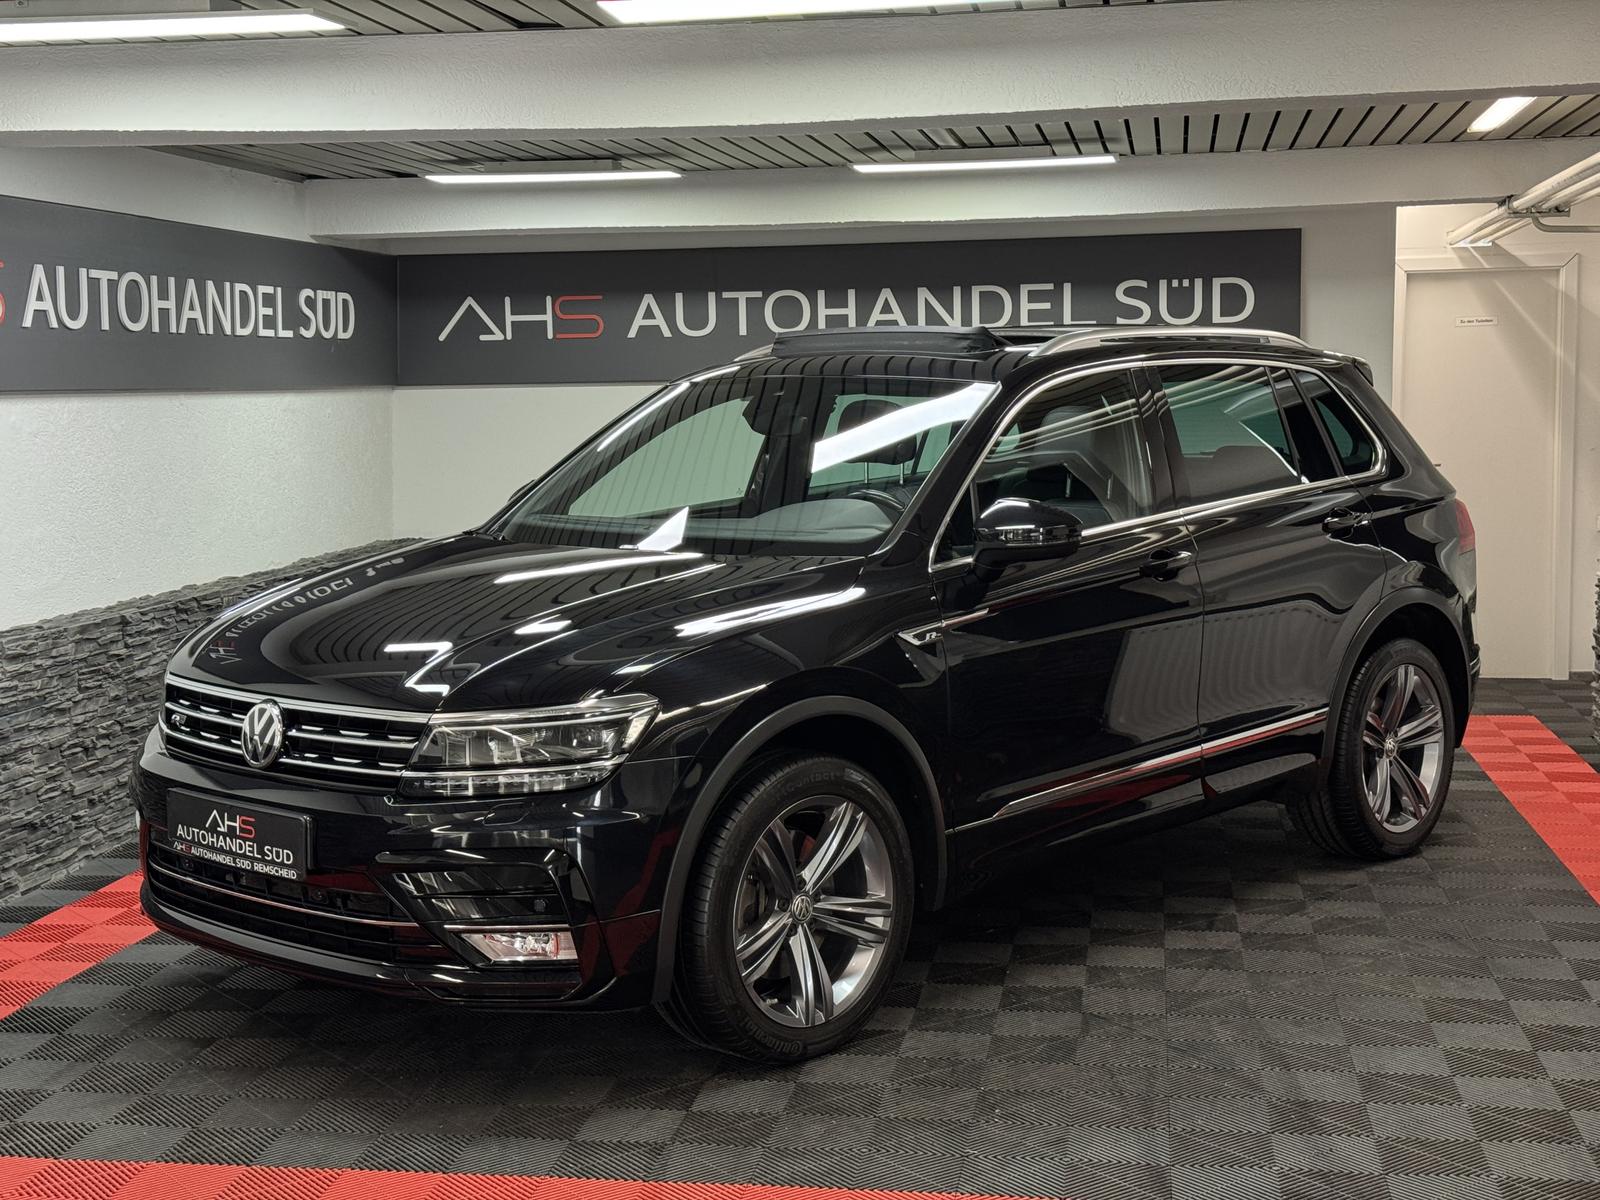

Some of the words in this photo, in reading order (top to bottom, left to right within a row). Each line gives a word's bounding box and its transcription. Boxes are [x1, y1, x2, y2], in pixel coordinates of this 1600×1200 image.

[21, 263, 294, 338] AUTOHANDEL
[299, 287, 355, 340] SÜD
[438, 295, 605, 341] AHS
[626, 282, 1097, 338] AUTOHANDEL
[1115, 276, 1256, 325] SÜD
[176, 823, 262, 859] AUTOHANDEL
[264, 845, 293, 864] SÜD
[205, 809, 256, 838] AHS
[190, 846, 236, 866] AUTOHANDEL
[236, 858, 252, 870] SÜD
[253, 862, 297, 880] REMSCHEID
